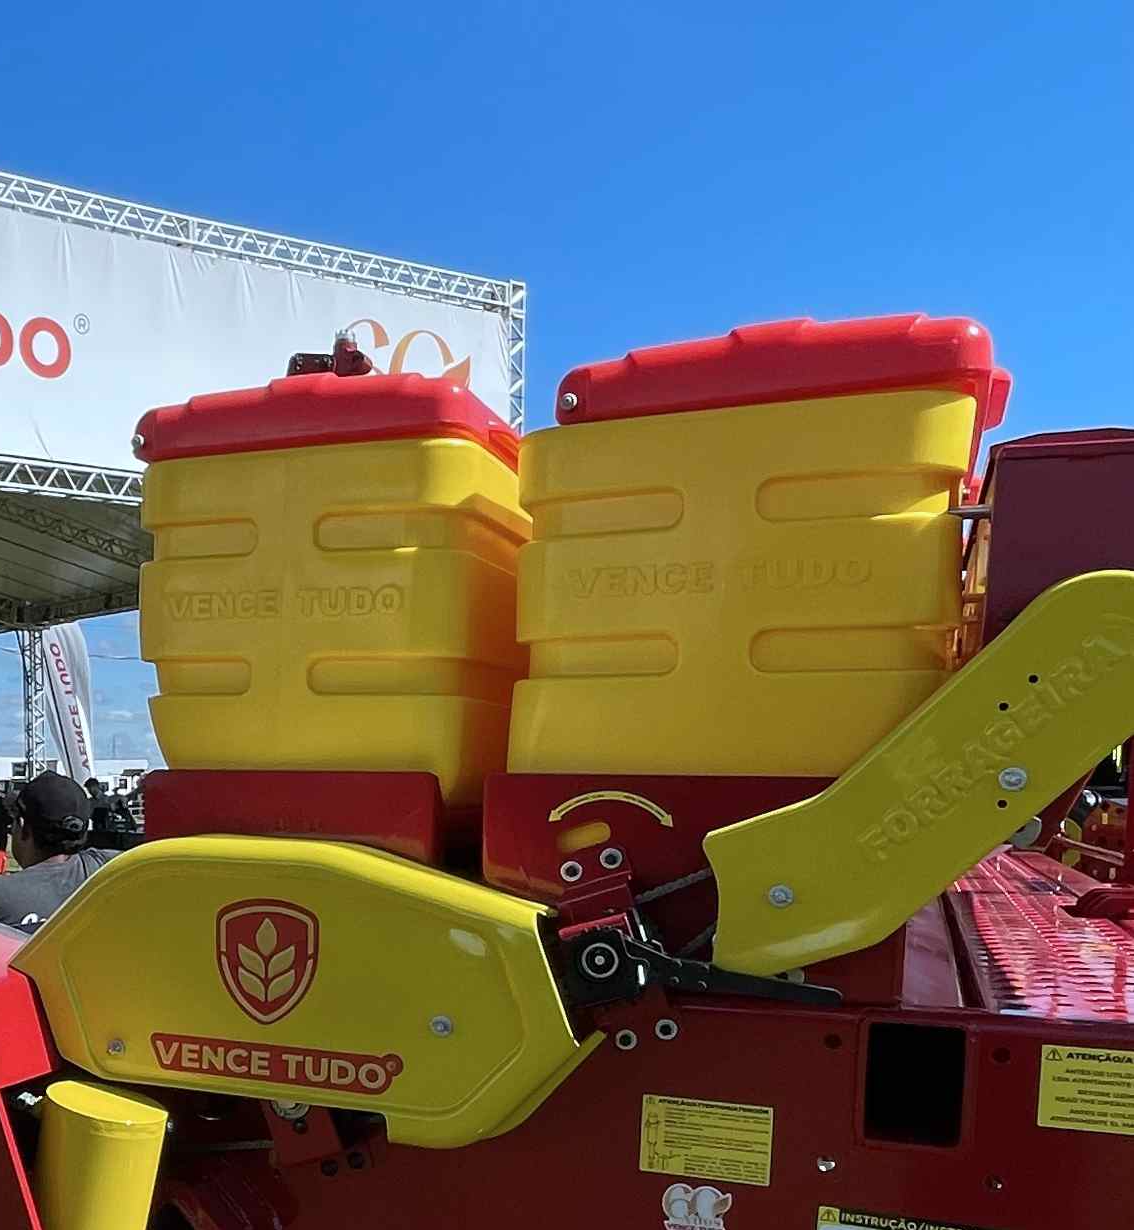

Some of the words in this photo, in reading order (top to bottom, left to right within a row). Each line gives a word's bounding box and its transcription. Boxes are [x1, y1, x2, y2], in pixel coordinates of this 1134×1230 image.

[569, 560, 715, 600] VENCE
[738, 557, 873, 592] TUDO
[168, 588, 280, 622] VENCE
[298, 584, 404, 618] TUDO
[156, 1040, 271, 1076] VENCE
[1066, 1052, 1134, 1064] ATENÇÃO/A
